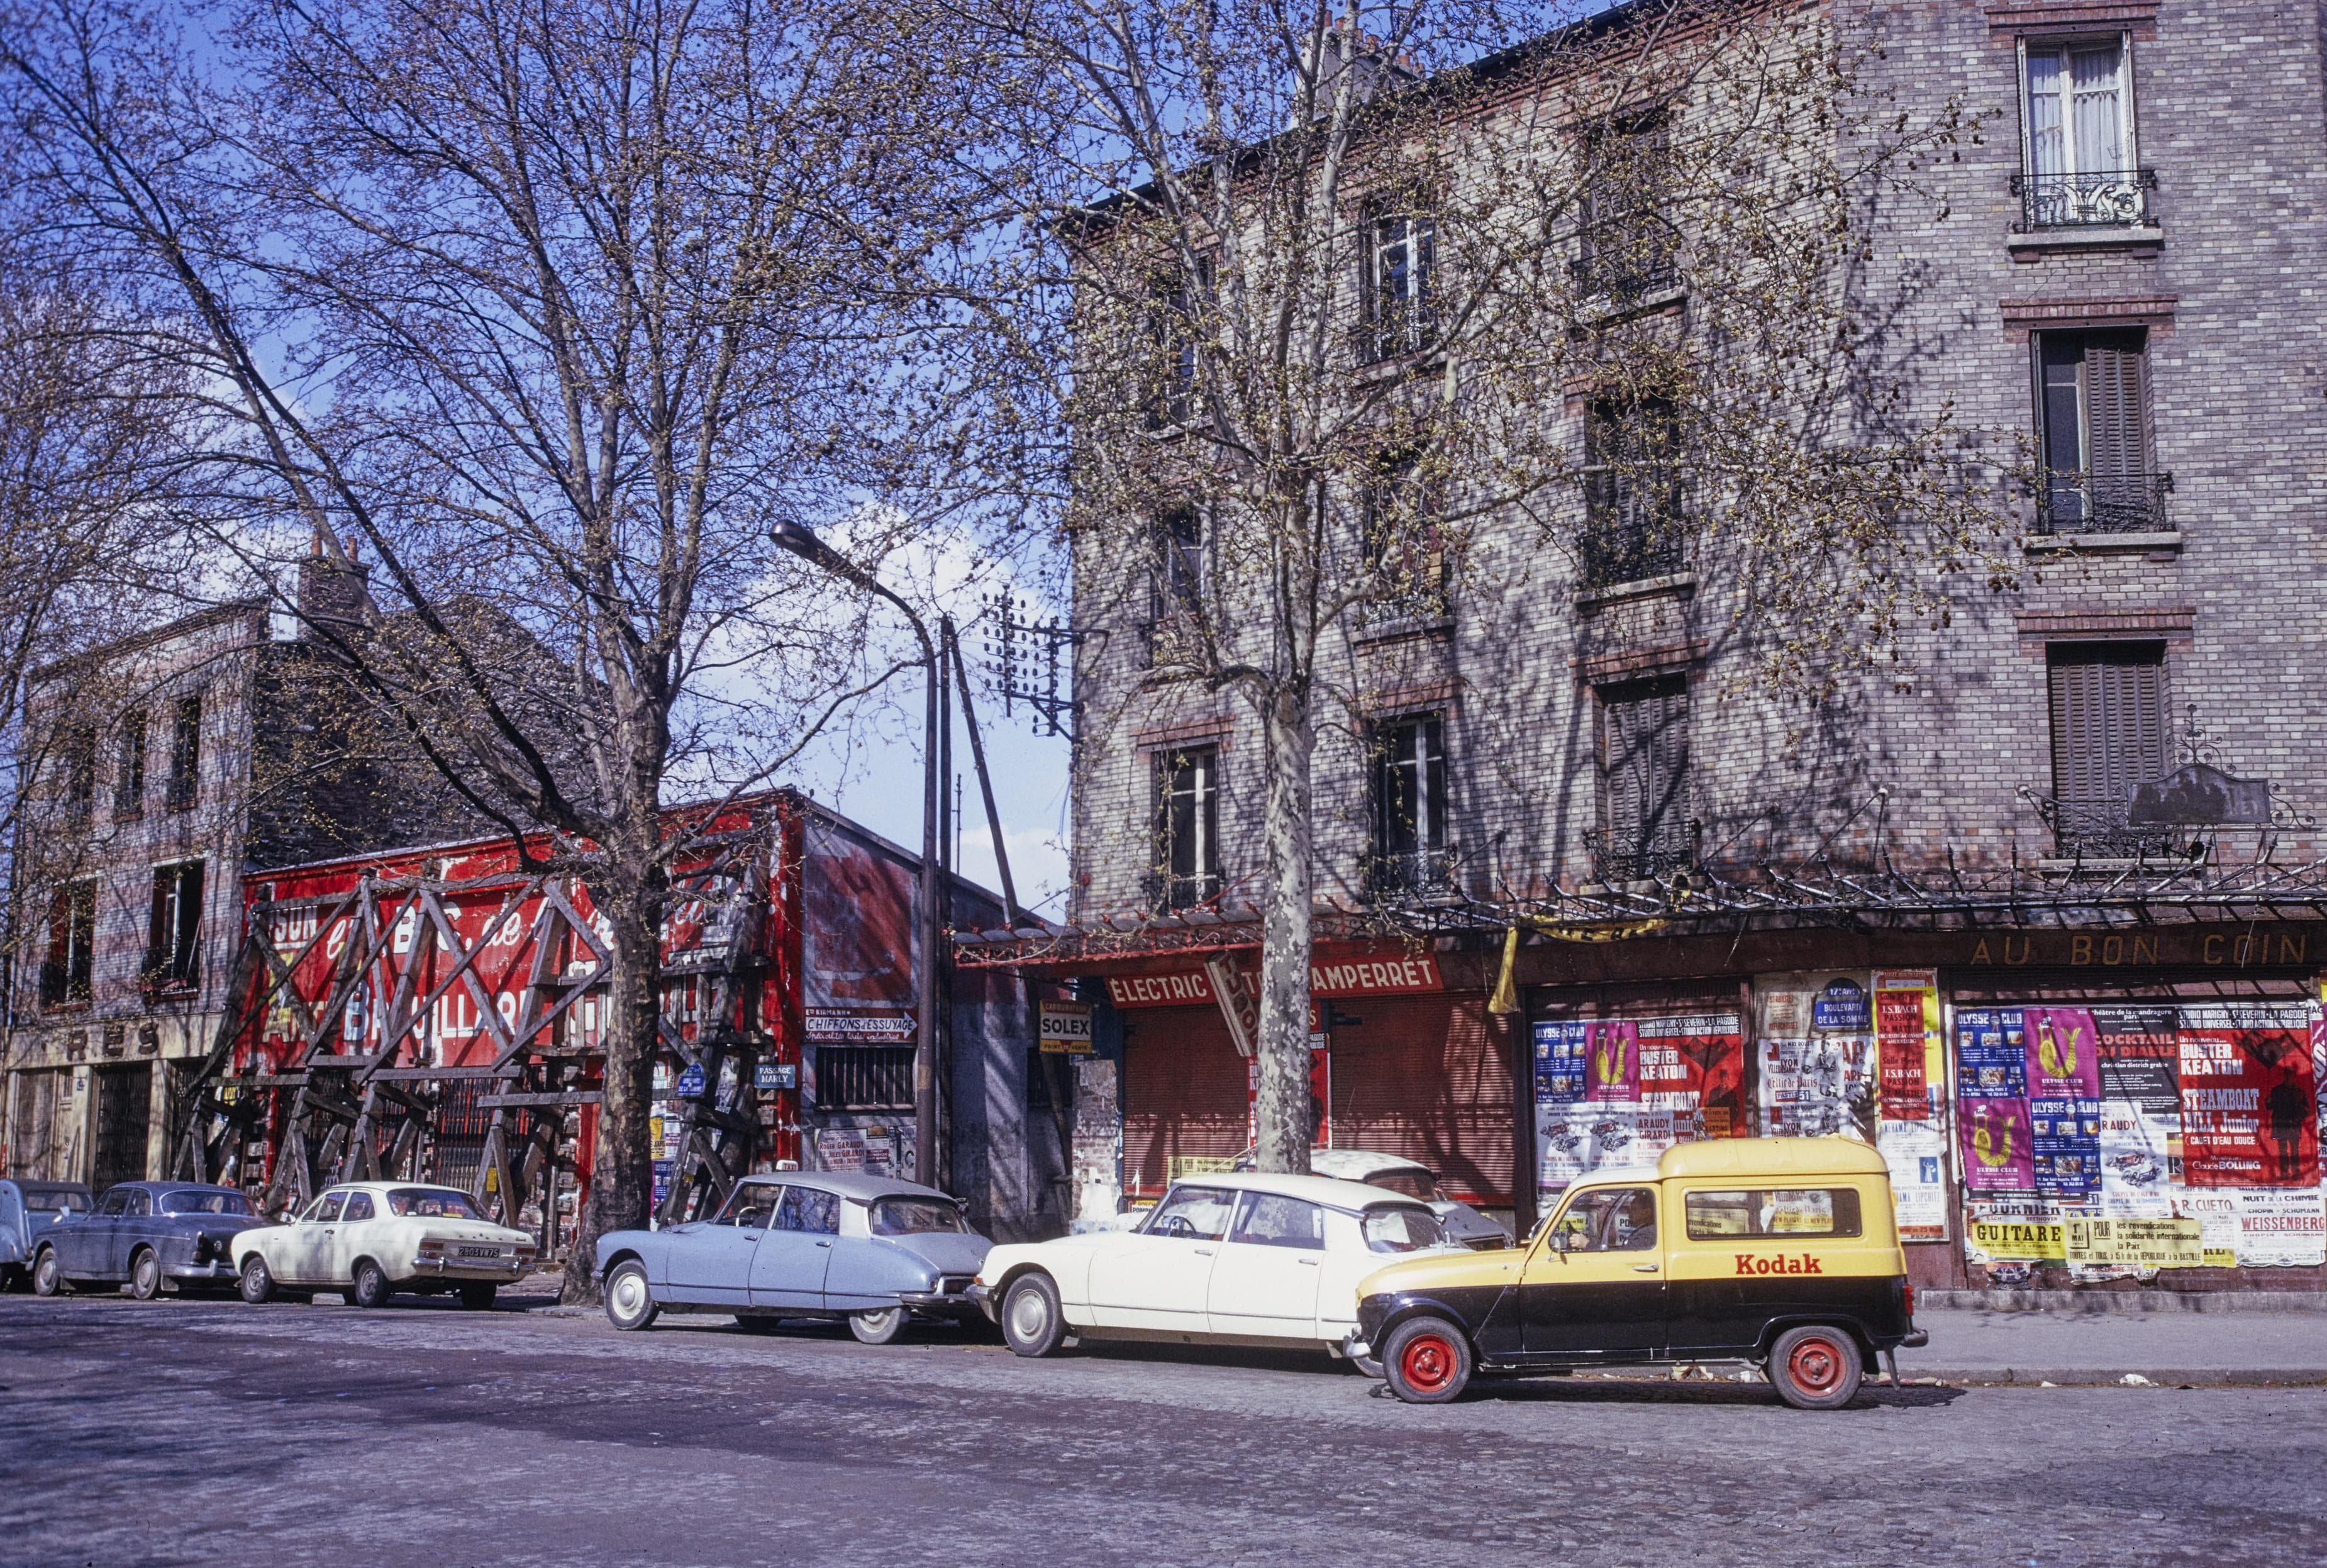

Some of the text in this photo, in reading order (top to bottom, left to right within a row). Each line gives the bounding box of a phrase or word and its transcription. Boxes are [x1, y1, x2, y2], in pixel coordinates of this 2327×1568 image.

[1970, 934, 2306, 965] AU BON COIN
[1309, 960, 1434, 991] AMPERRET
[1824, 1003, 1862, 1013] BOULEVARD
[1818, 1015, 1868, 1024] DE LA SOMME
[1958, 1013, 2023, 1025] ULYSSE CLUB
[2179, 1010, 2201, 1020] STUDIO
[2202, 1010, 2229, 1019] MARIGNY
[2239, 1009, 2266, 1019] SEVERIN
[2269, 1010, 2278, 1019] LA
[2280, 1009, 2308, 1019] PAGODE
[808, 1018, 861, 1030] CHIFFONS
[1042, 1018, 1089, 1035] SOLEX
[1708, 1017, 1715, 1026] LA
[1716, 1016, 1738, 1026] PAGODE
[2179, 1019, 2202, 1029] STUDIO
[2202, 1019, 2233, 1028] UNIVERSEL
[2235, 1019, 2255, 1028] STUDIO
[2255, 1019, 2274, 1028] ACTION
[1535, 1026, 1585, 1038] ULYSSE CLUB
[2095, 1033, 2175, 1045] COCKTAIL
[2120, 1045, 2176, 1057] DIABLE
[2180, 1043, 2232, 1059] BUSTER
[1639, 1050, 1679, 1065] BUSTER
[1780, 1058, 1799, 1067] LYON
[1882, 1057, 1898, 1065] Salle
[759, 1067, 791, 1075] PASSAGE
[1640, 1064, 1687, 1081] KEATON
[2180, 1059, 2243, 1076] KEATON
[761, 1075, 788, 1083] MARLY
[1797, 1076, 1818, 1091] Paris
[1887, 1077, 1920, 1086] PASSION
[1777, 1090, 1810, 1101] PASTIS 51
[2182, 1088, 2260, 1111] STEAMBOAT
[2031, 1101, 2098, 1113] ULYSSE CLUB
[1636, 1118, 1670, 1129] ARAUDY
[1784, 1122, 1801, 1131] LYON
[2184, 1111, 2260, 1133] BILL Junior
[837, 1141, 865, 1149] GARAUDY
[2190, 1136, 2256, 1145] CADET D'EAU DOUCE
[2192, 1160, 2261, 1170] Claude BOLLING
[2085, 1194, 2099, 1204] 51
[2182, 1199, 2233, 1211] R. CUETO
[1689, 1219, 1722, 1228] evendications
[2241, 1216, 2325, 1230] WEISSENBERG
[1977, 1225, 2062, 1242] GUITARE
[2094, 1221, 2111, 1237] POUR
[2125, 1231, 2155, 1240] solidarité
[2157, 1232, 2201, 1241] internationale
[2118, 1242, 2141, 1250] la Paix
[2069, 1251, 2087, 1260] TOUTES
[2095, 1251, 2108, 1260] TOUS
[2179, 1252, 2201, 1262] BASTILLE
[1735, 1253, 1823, 1275] Kodak
